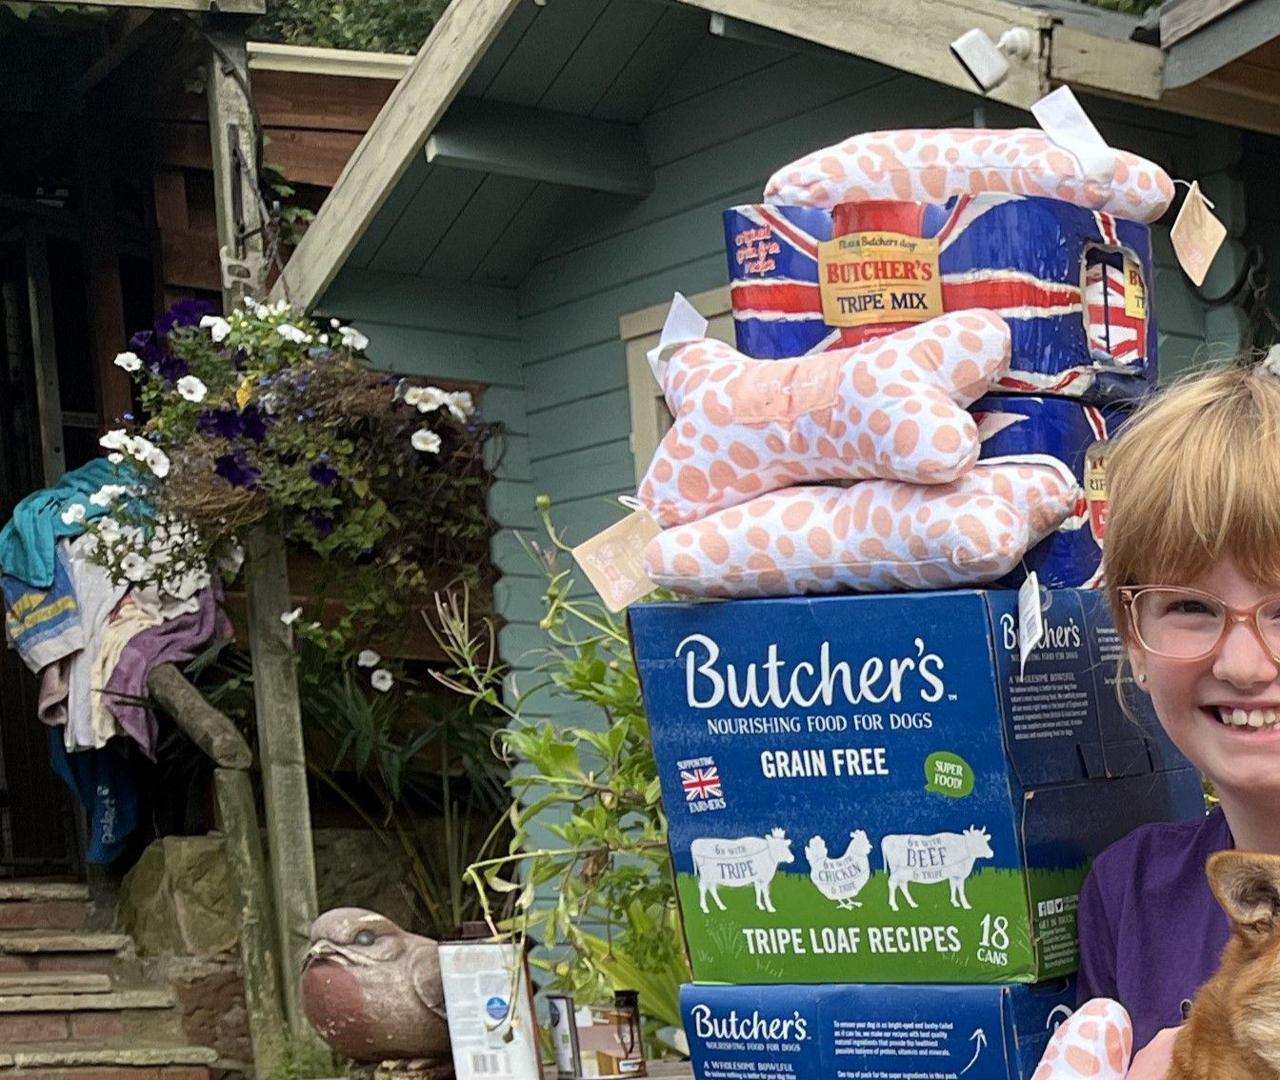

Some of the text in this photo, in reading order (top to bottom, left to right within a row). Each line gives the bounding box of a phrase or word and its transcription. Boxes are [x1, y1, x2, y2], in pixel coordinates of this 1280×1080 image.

[826, 261, 933, 284] BUTCHER'S
[837, 292, 928, 315] TRIPE MIX
[1000, 613, 1081, 650] Bcher's
[675, 633, 945, 710] Butcher's
[706, 711, 932, 736] NOURISHING FOOD FOR DOGS
[760, 748, 889, 778] GRAIN FREE
[934, 759, 963, 776] SUPER
[934, 775, 962, 790] FOOD!
[717, 860, 757, 880] TRIPE
[907, 847, 947, 869] BEEF
[742, 926, 962, 954] TRIPE LOAF RECIPES
[978, 913, 1010, 949] 18
[977, 949, 1007, 967] CANS
[690, 1004, 808, 1040] Butcher's
